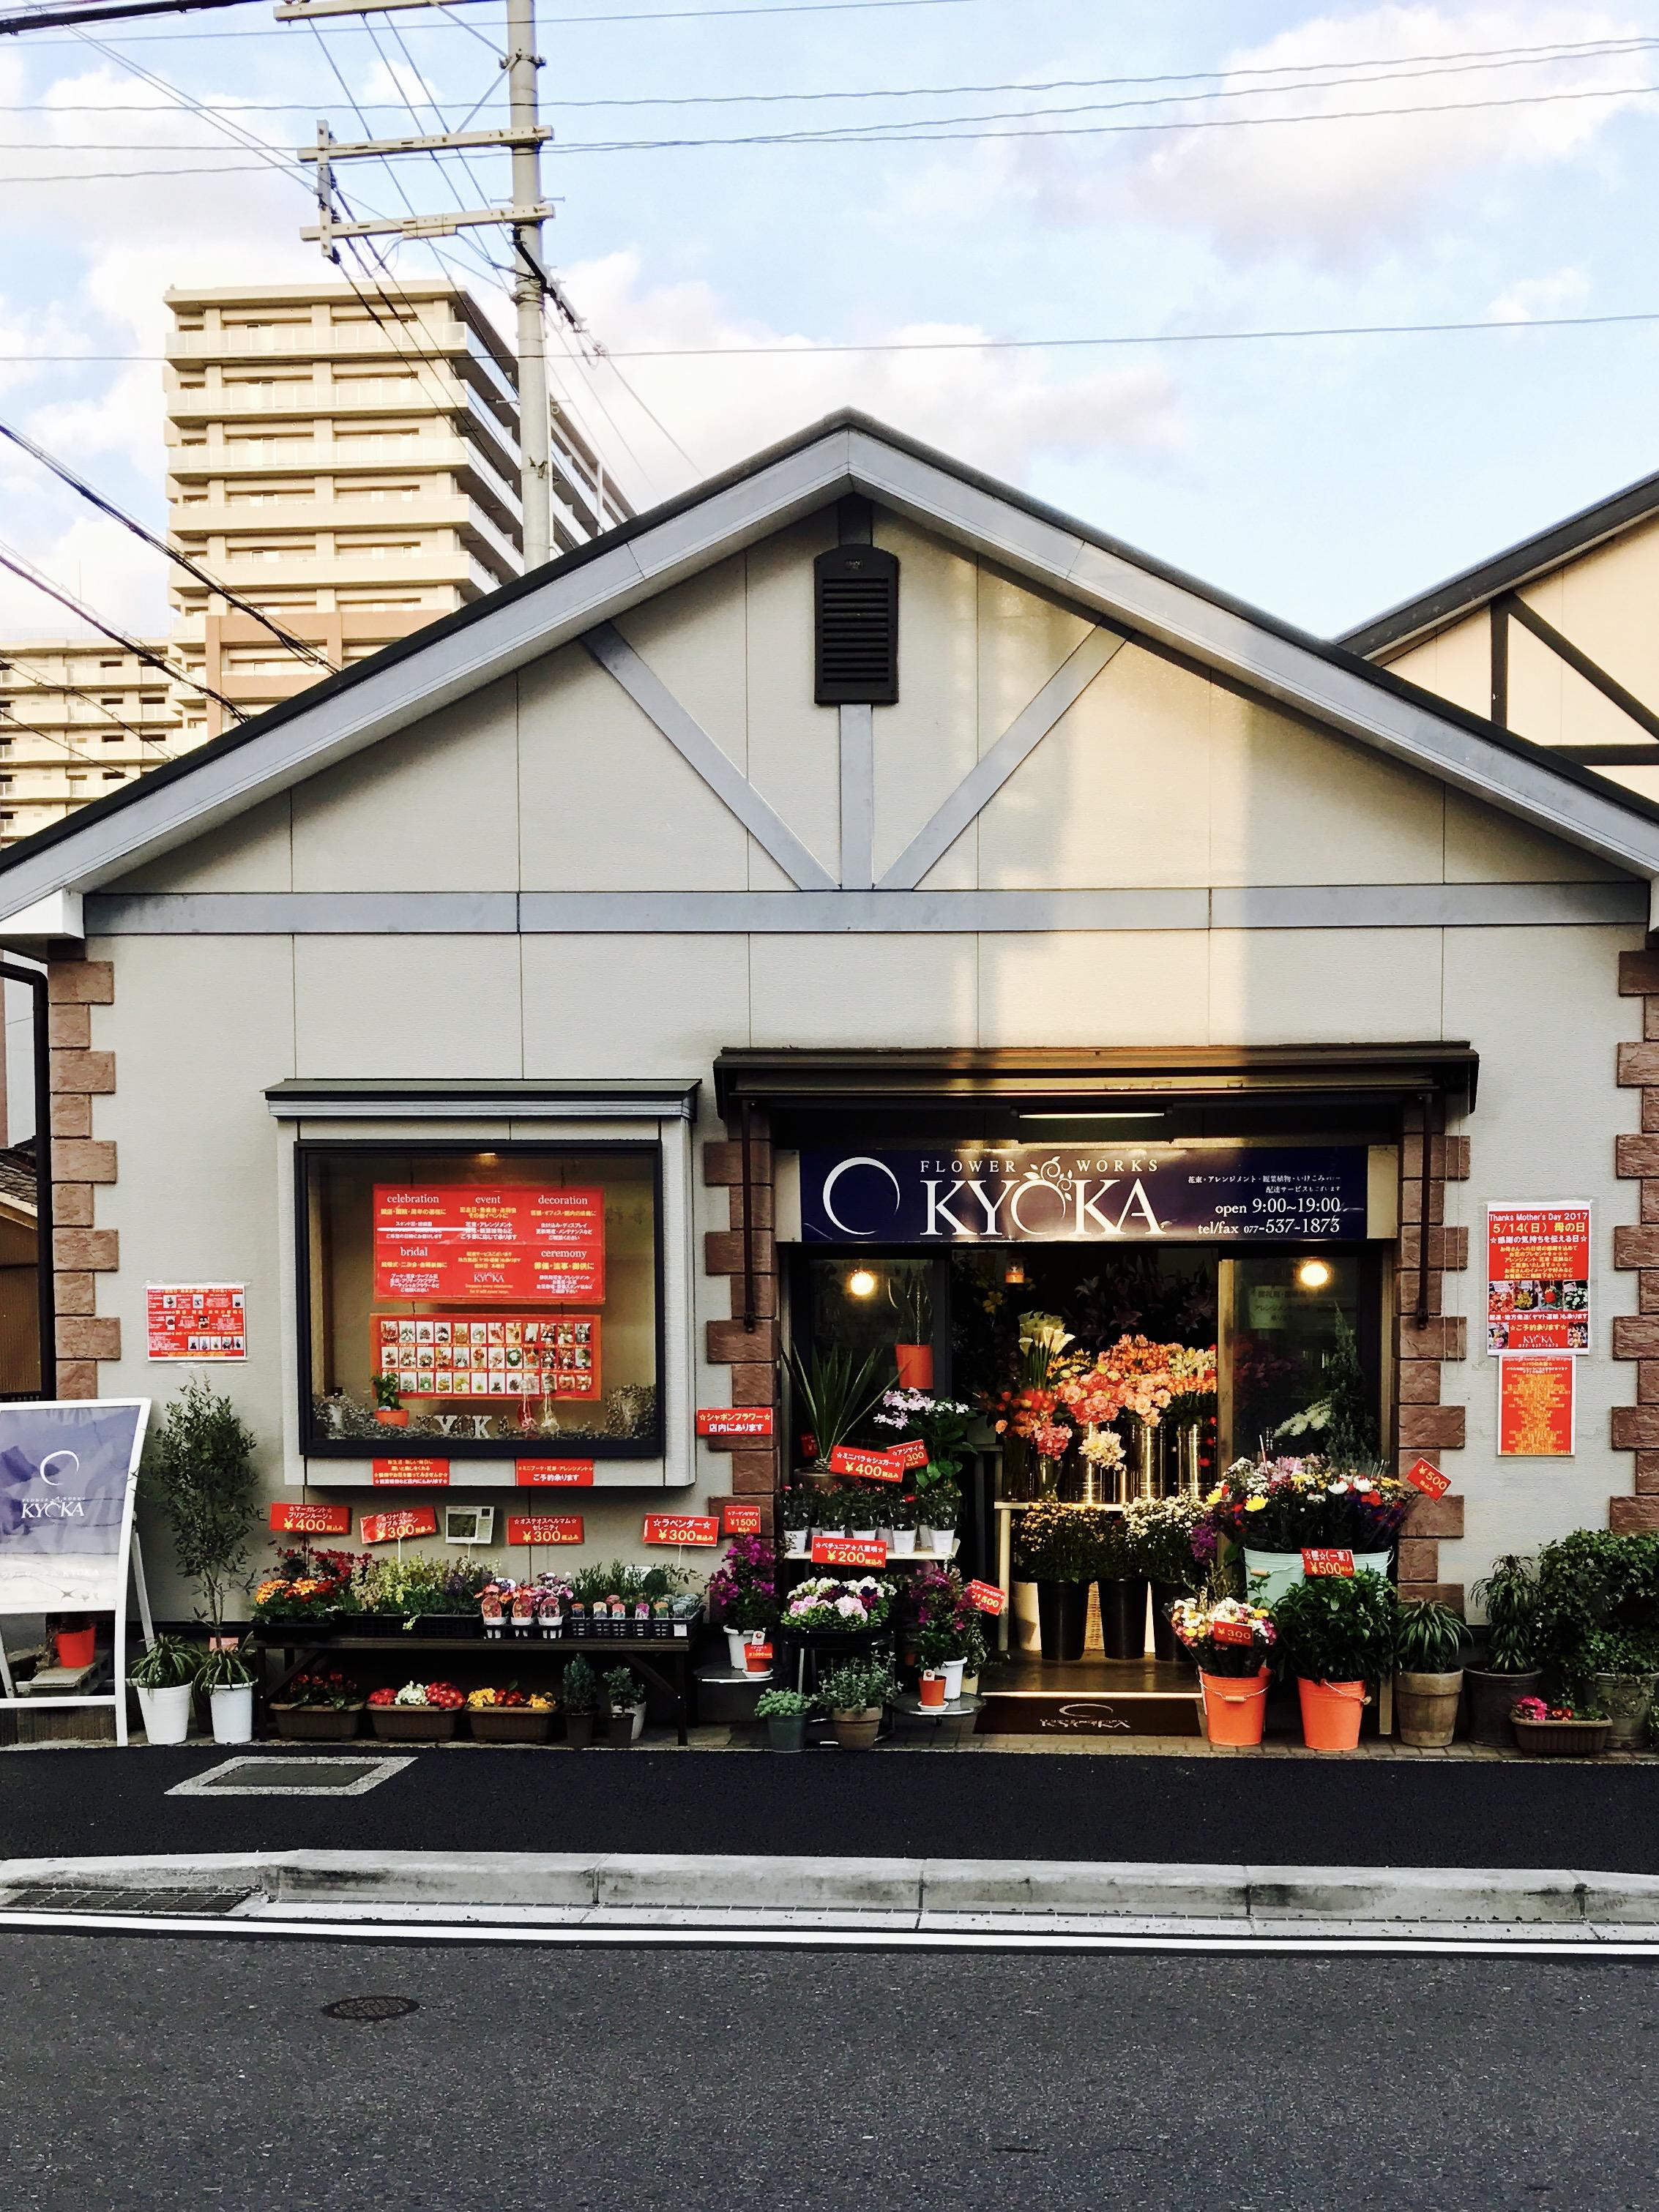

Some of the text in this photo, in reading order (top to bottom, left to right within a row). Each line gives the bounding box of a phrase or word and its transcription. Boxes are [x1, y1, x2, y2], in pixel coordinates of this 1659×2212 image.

[920, 1159, 1158, 1173] FLOWER WORKS
[387, 1193, 439, 1203] celebration
[475, 1195, 501, 1204] event
[537, 1195, 588, 1205] decoration
[920, 1178, 1168, 1236] KYOKA
[1215, 1205, 1247, 1217] open
[1489, 1212, 1588, 1222] Thanks Mother's Day 2017
[1198, 1218, 1341, 1234] tel/fax 077-537-1873
[1554, 1222, 1585, 1233] 母の日
[1498, 1235, 1579, 1244] 感謝の気持ちを伝える日
[400, 1246, 428, 1257] bridal
[540, 1250, 587, 1260] ceremony
[707, 1413, 764, 1421] シャボンフラワー
[709, 1423, 764, 1432] 店内にあります
[533, 1473, 580, 1482] ご予約承ります
[1418, 1465, 1447, 1490] ¥500
[21, 1501, 84, 1519] KYOKA
[662, 1518, 703, 1529] ラベンダー
[730, 1518, 757, 1527] ¥1500
[1218, 1627, 1251, 1640] ¥300
